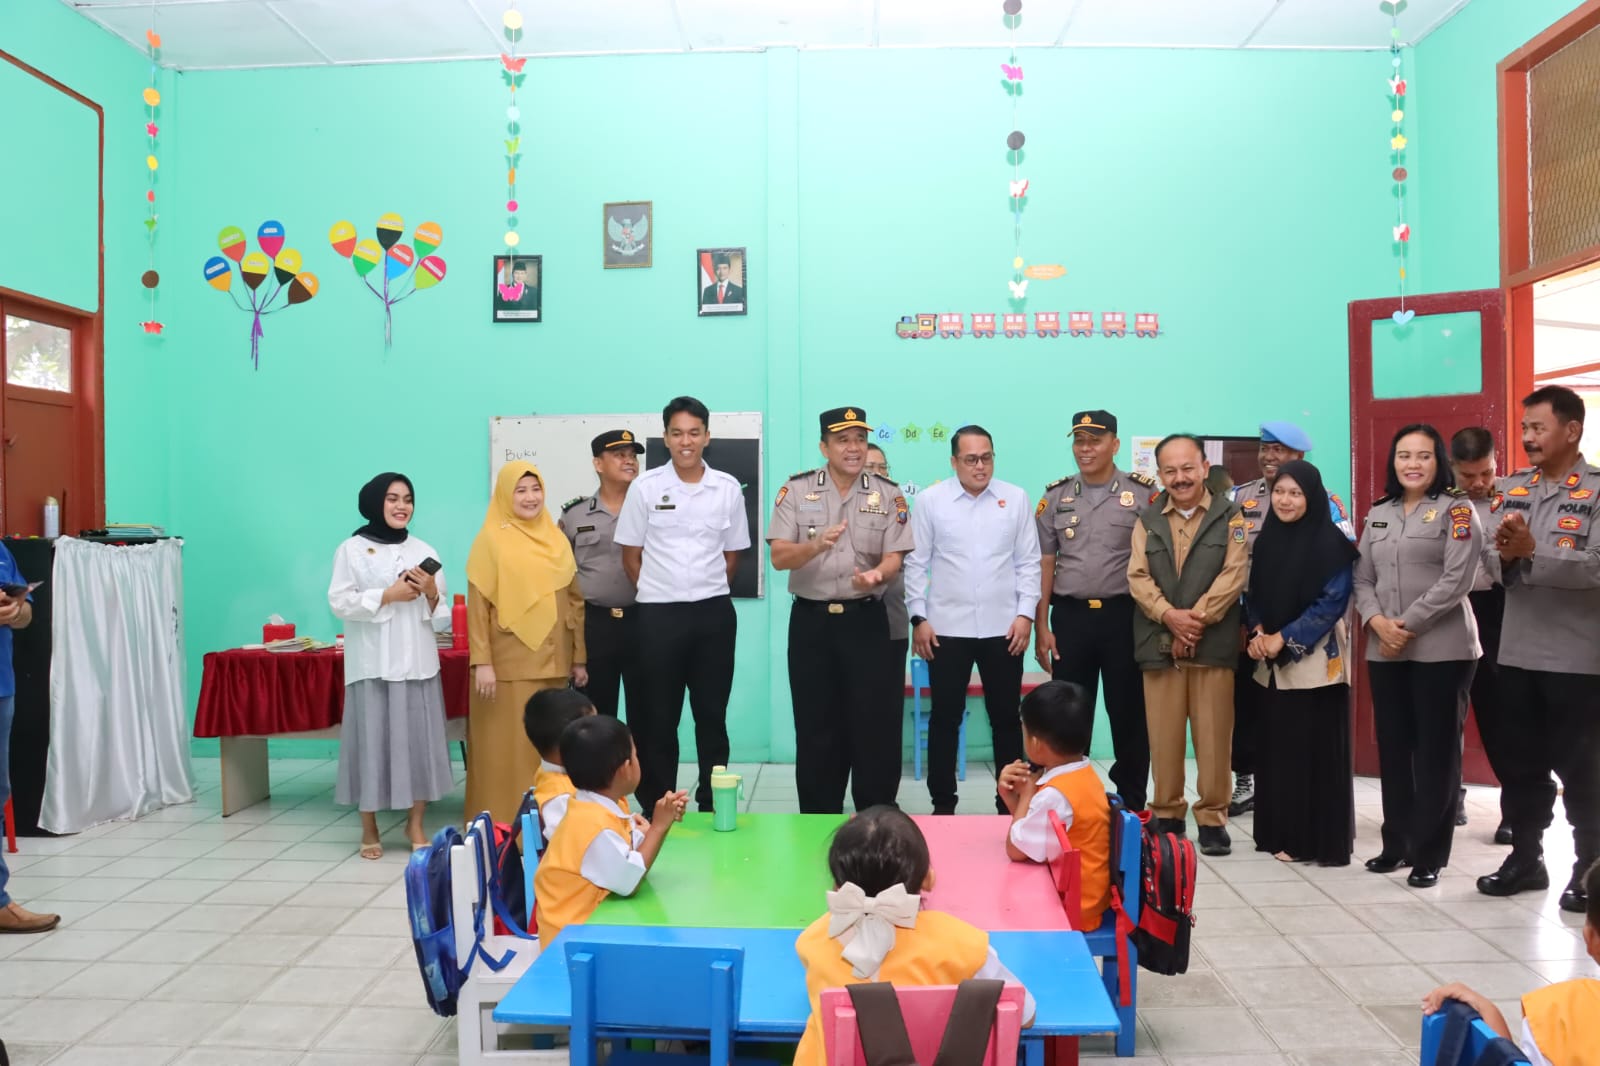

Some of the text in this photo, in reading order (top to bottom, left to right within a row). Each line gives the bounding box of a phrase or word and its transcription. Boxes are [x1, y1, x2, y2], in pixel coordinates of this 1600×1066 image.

[878, 428, 944, 439] Cc Dd Ee
[904, 485, 916, 495] Jj
[1557, 503, 1593, 516] POLRI
